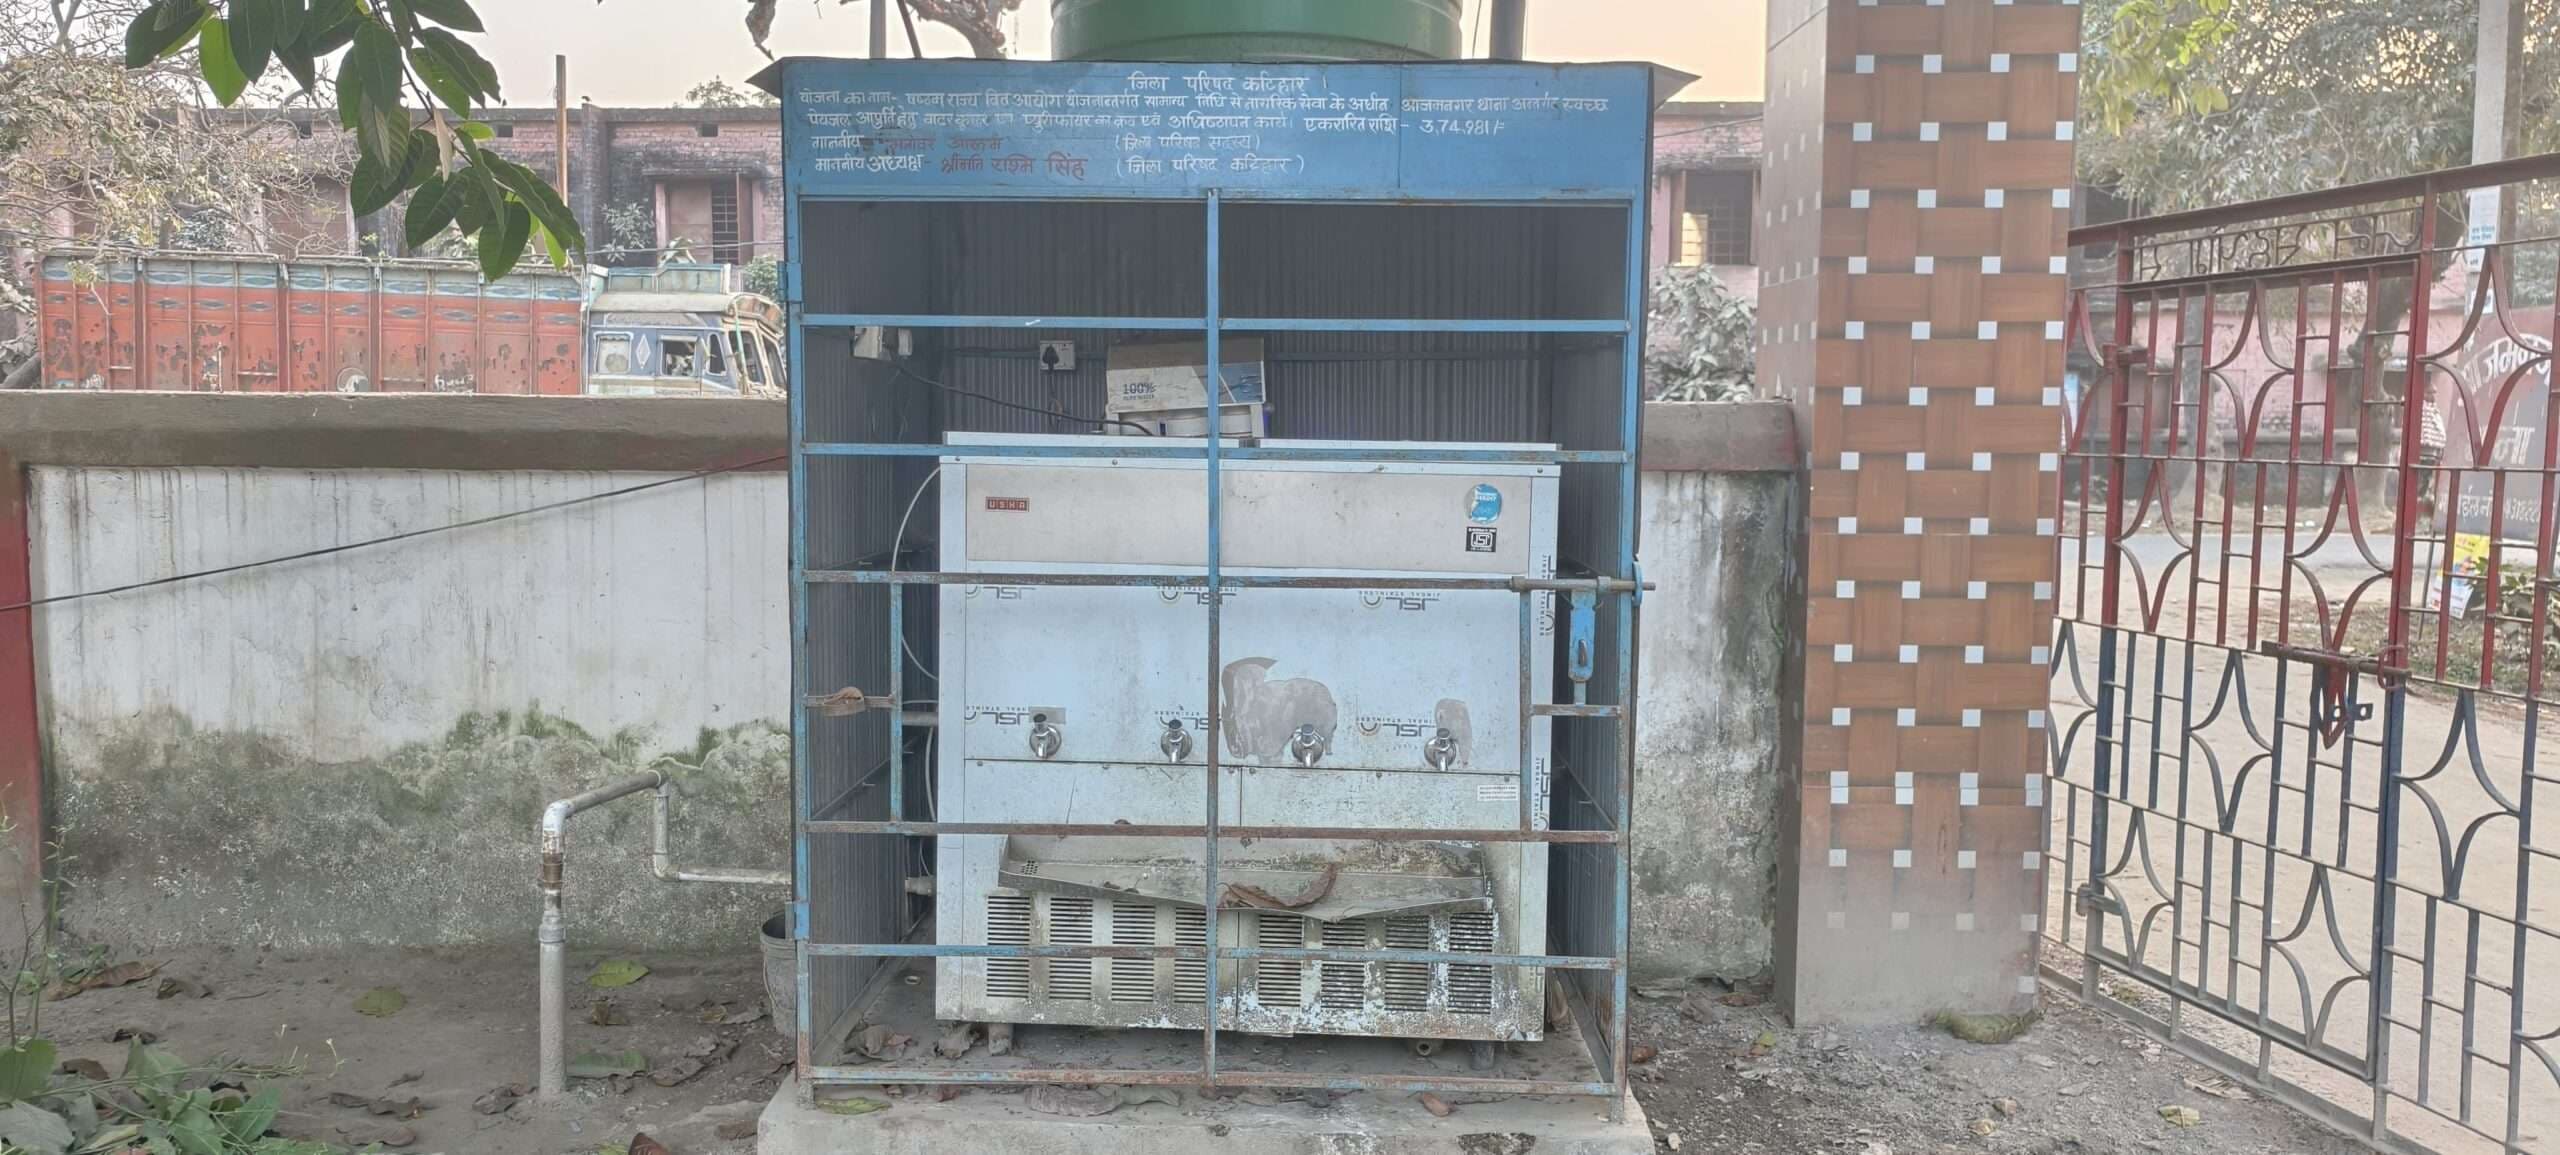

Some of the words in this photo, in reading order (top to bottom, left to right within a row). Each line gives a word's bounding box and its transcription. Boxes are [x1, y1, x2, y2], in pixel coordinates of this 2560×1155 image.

[1128, 71, 1169, 91] जिला
[1242, 70, 1310, 93] कटिहार
[815, 152, 865, 172] माननीय
[1044, 150, 1089, 180] सिंह
[989, 500, 1025, 510] USHA
[983, 586, 1036, 600] JSL
[1385, 597, 1440, 611] JSL
[982, 711, 1030, 726] JSL
[1382, 723, 1435, 737] JSL
